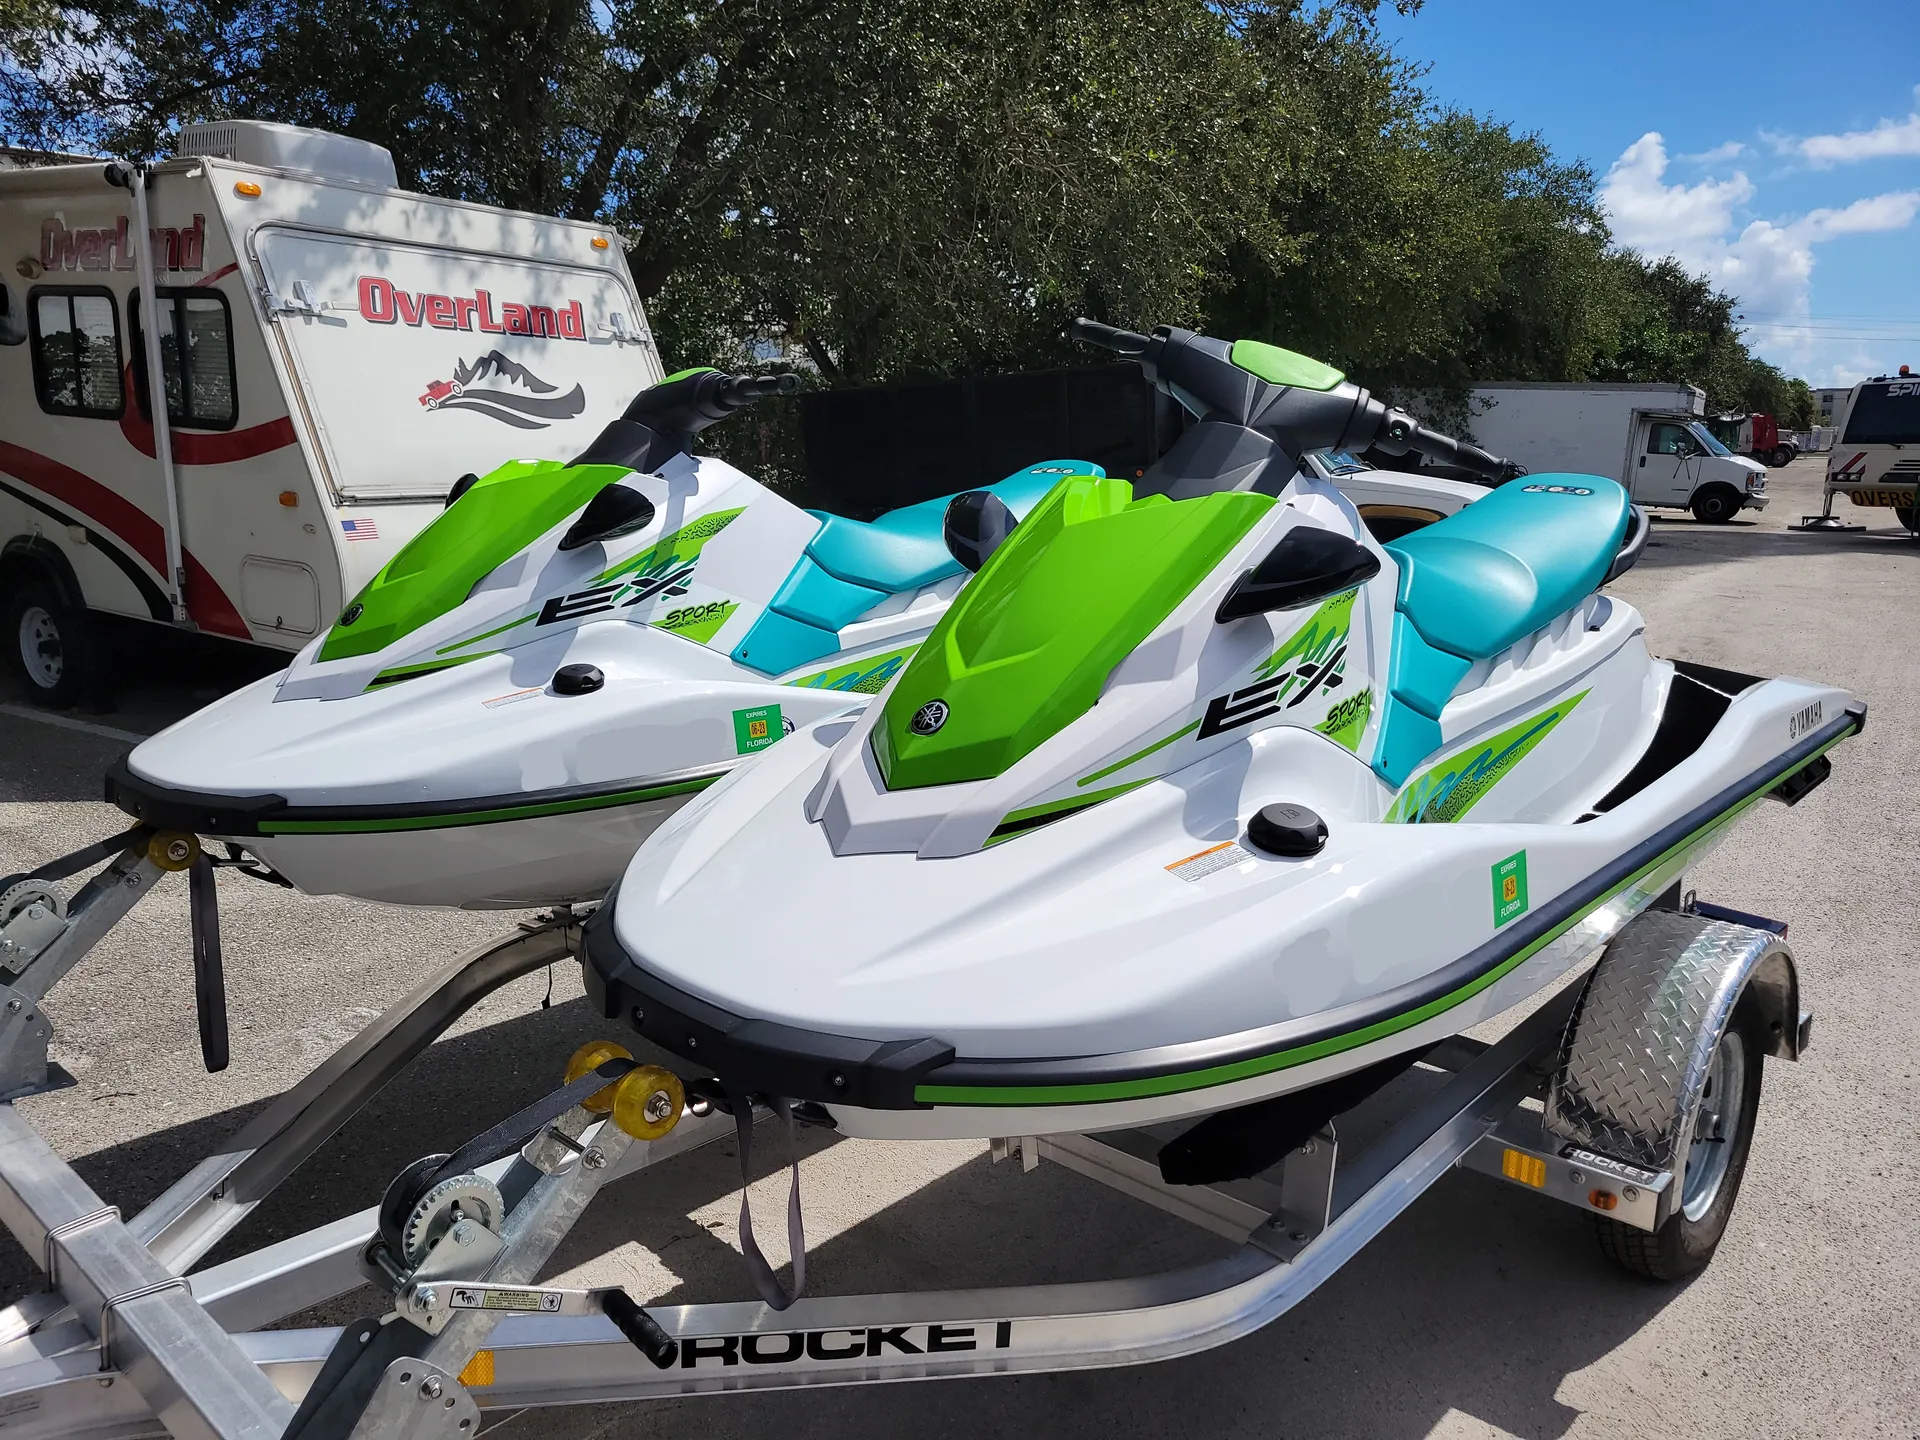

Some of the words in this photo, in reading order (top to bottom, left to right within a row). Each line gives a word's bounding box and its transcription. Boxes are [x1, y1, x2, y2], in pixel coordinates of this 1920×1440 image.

[357, 275, 588, 341] OverLand
[535, 567, 696, 628] EX
[664, 599, 731, 626] SPORT
[1195, 643, 1348, 742] EX
[1325, 685, 1371, 730] SPORT
[745, 709, 768, 719] EXPIRES
[750, 721, 766, 736] 06-23
[1796, 699, 1823, 737] YAMAHA
[746, 737, 774, 748] FLORIDA
[1500, 899, 1521, 918] FLORIDA
[1564, 1146, 1655, 1180] ROCKET
